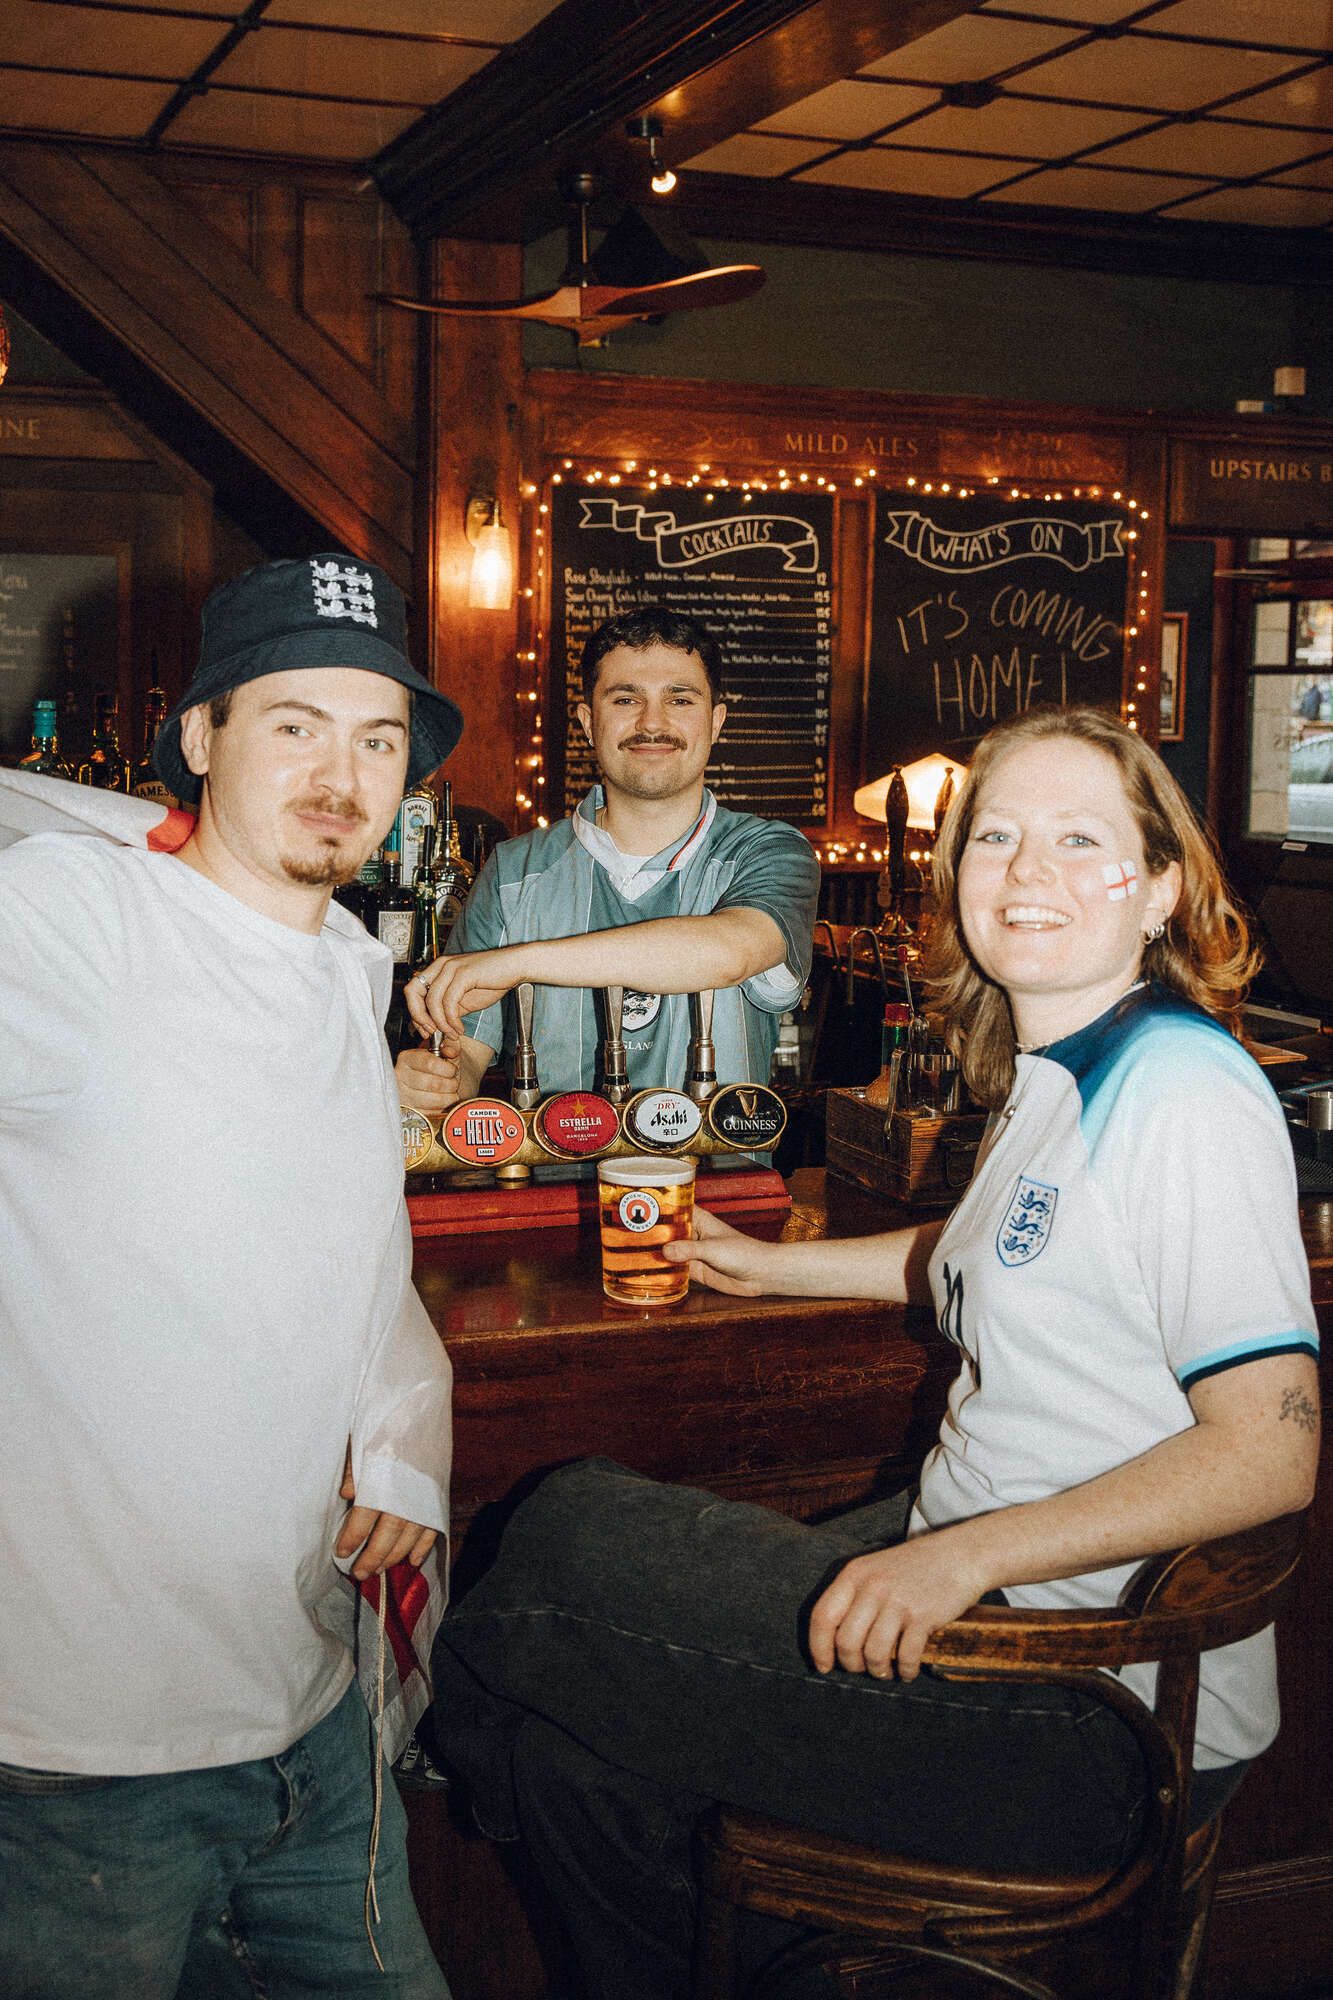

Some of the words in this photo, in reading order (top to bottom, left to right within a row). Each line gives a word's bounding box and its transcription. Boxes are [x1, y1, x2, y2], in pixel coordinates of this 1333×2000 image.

[785, 432, 849, 453] MILD
[864, 436, 918, 457] ALES
[1209, 458, 1312, 480] UPSTAIRS
[680, 521, 774, 559] COCKTAILS
[929, 527, 1011, 562] WHAT'S
[1030, 523, 1064, 551] ON
[896, 590, 969, 654] IT'S
[990, 585, 1119, 661] COMING
[559, 1116, 602, 1128] ESTRELLA
[650, 1109, 688, 1127] Asahi
[723, 1118, 777, 1131] GUINNESS
[466, 1119, 505, 1145] HELLS
